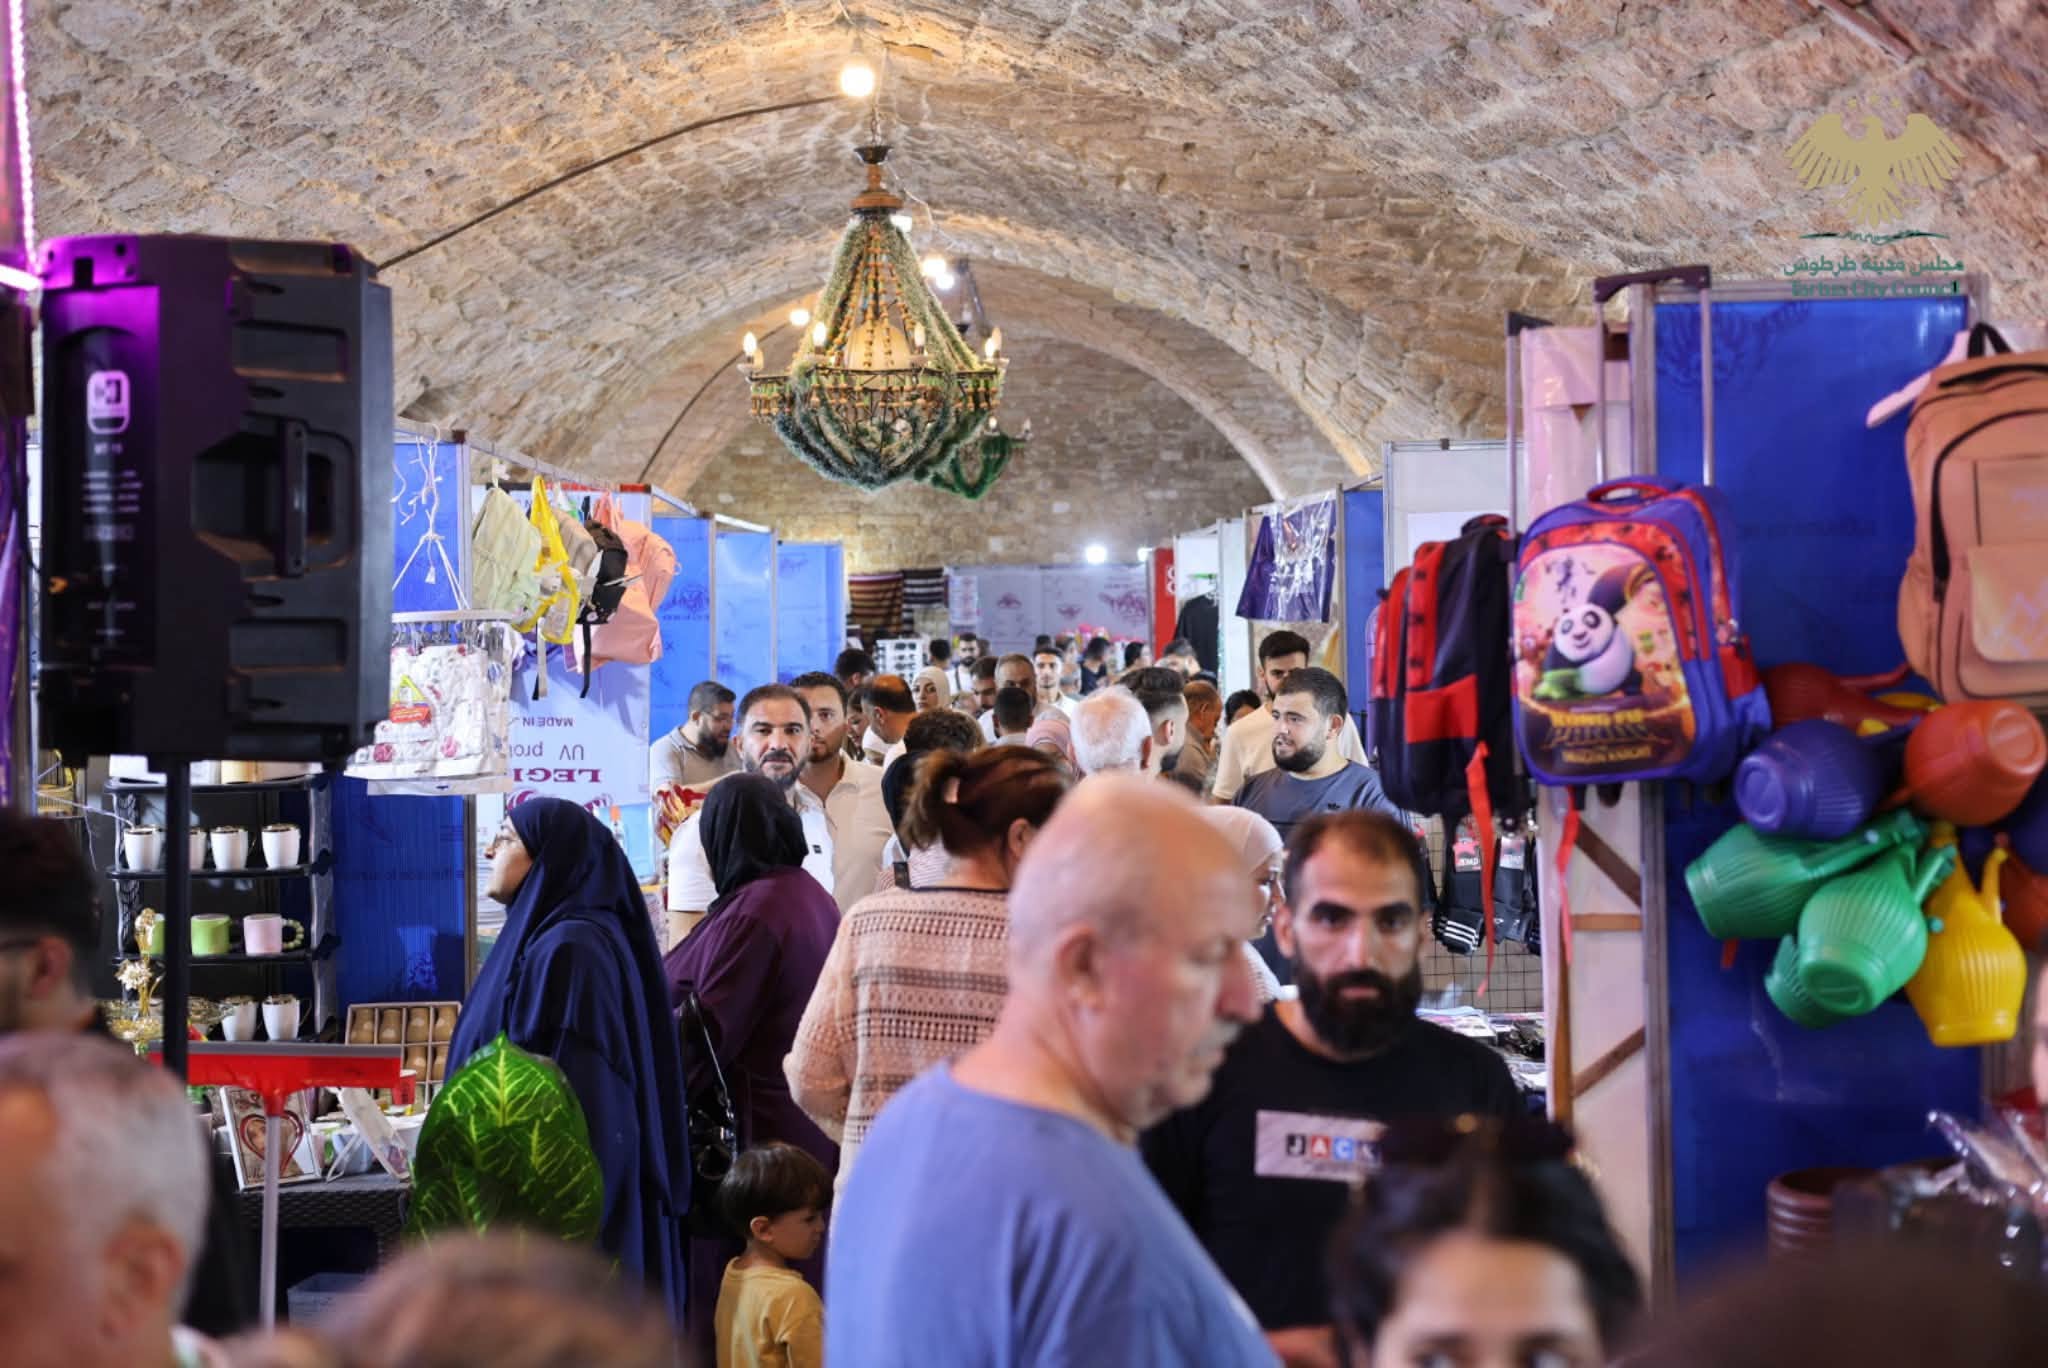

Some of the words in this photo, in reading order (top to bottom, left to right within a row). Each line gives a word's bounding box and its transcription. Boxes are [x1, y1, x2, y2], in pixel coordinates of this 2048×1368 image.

[522, 716, 535, 728] IN
[536, 716, 574, 728] MADE
[559, 743, 585, 761] UV
